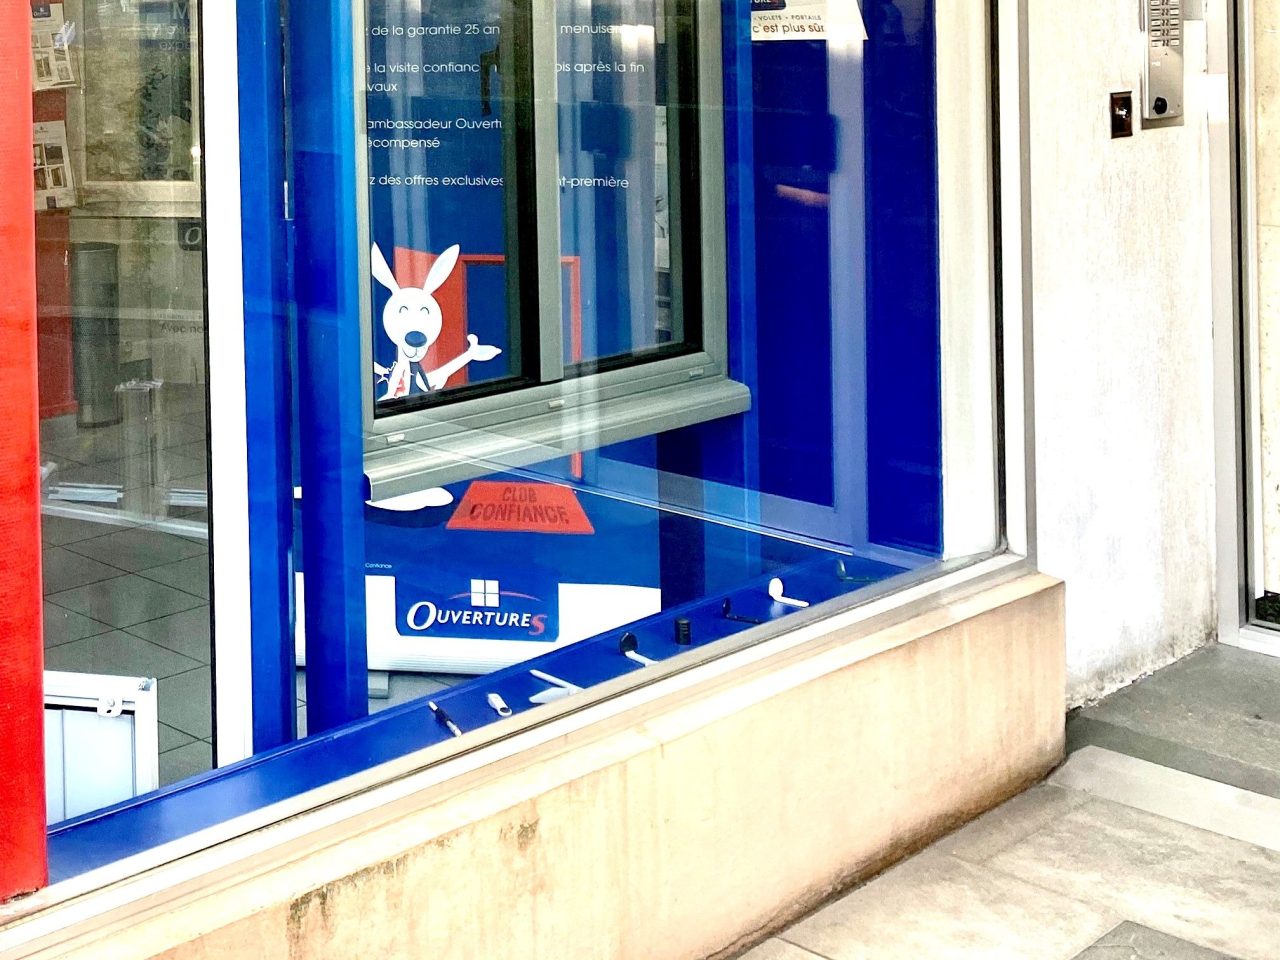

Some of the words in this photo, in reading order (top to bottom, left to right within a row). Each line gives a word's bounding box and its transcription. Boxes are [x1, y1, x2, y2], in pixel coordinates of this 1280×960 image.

[371, 24, 389, 37] de
[391, 24, 404, 37] la
[407, 24, 461, 41] garantie
[464, 23, 480, 35] 25
[483, 25, 500, 36] an
[752, 22, 779, 34] c'est
[781, 22, 805, 37] plus
[374, 62, 386, 73] la
[389, 62, 420, 73] visite
[423, 62, 480, 73] confianc
[556, 63, 571, 73] ois
[573, 60, 611, 76] après
[614, 62, 626, 73] la
[629, 62, 645, 73] fin
[367, 81, 398, 92] vaux
[455, 118, 502, 130] Ouvert
[367, 136, 441, 150] écompensé
[379, 174, 402, 186] des
[404, 174, 439, 186] offres
[441, 175, 504, 187] exclusives
[501, 486, 537, 503] CLUB
[406, 600, 548, 637] OUVERTURES
